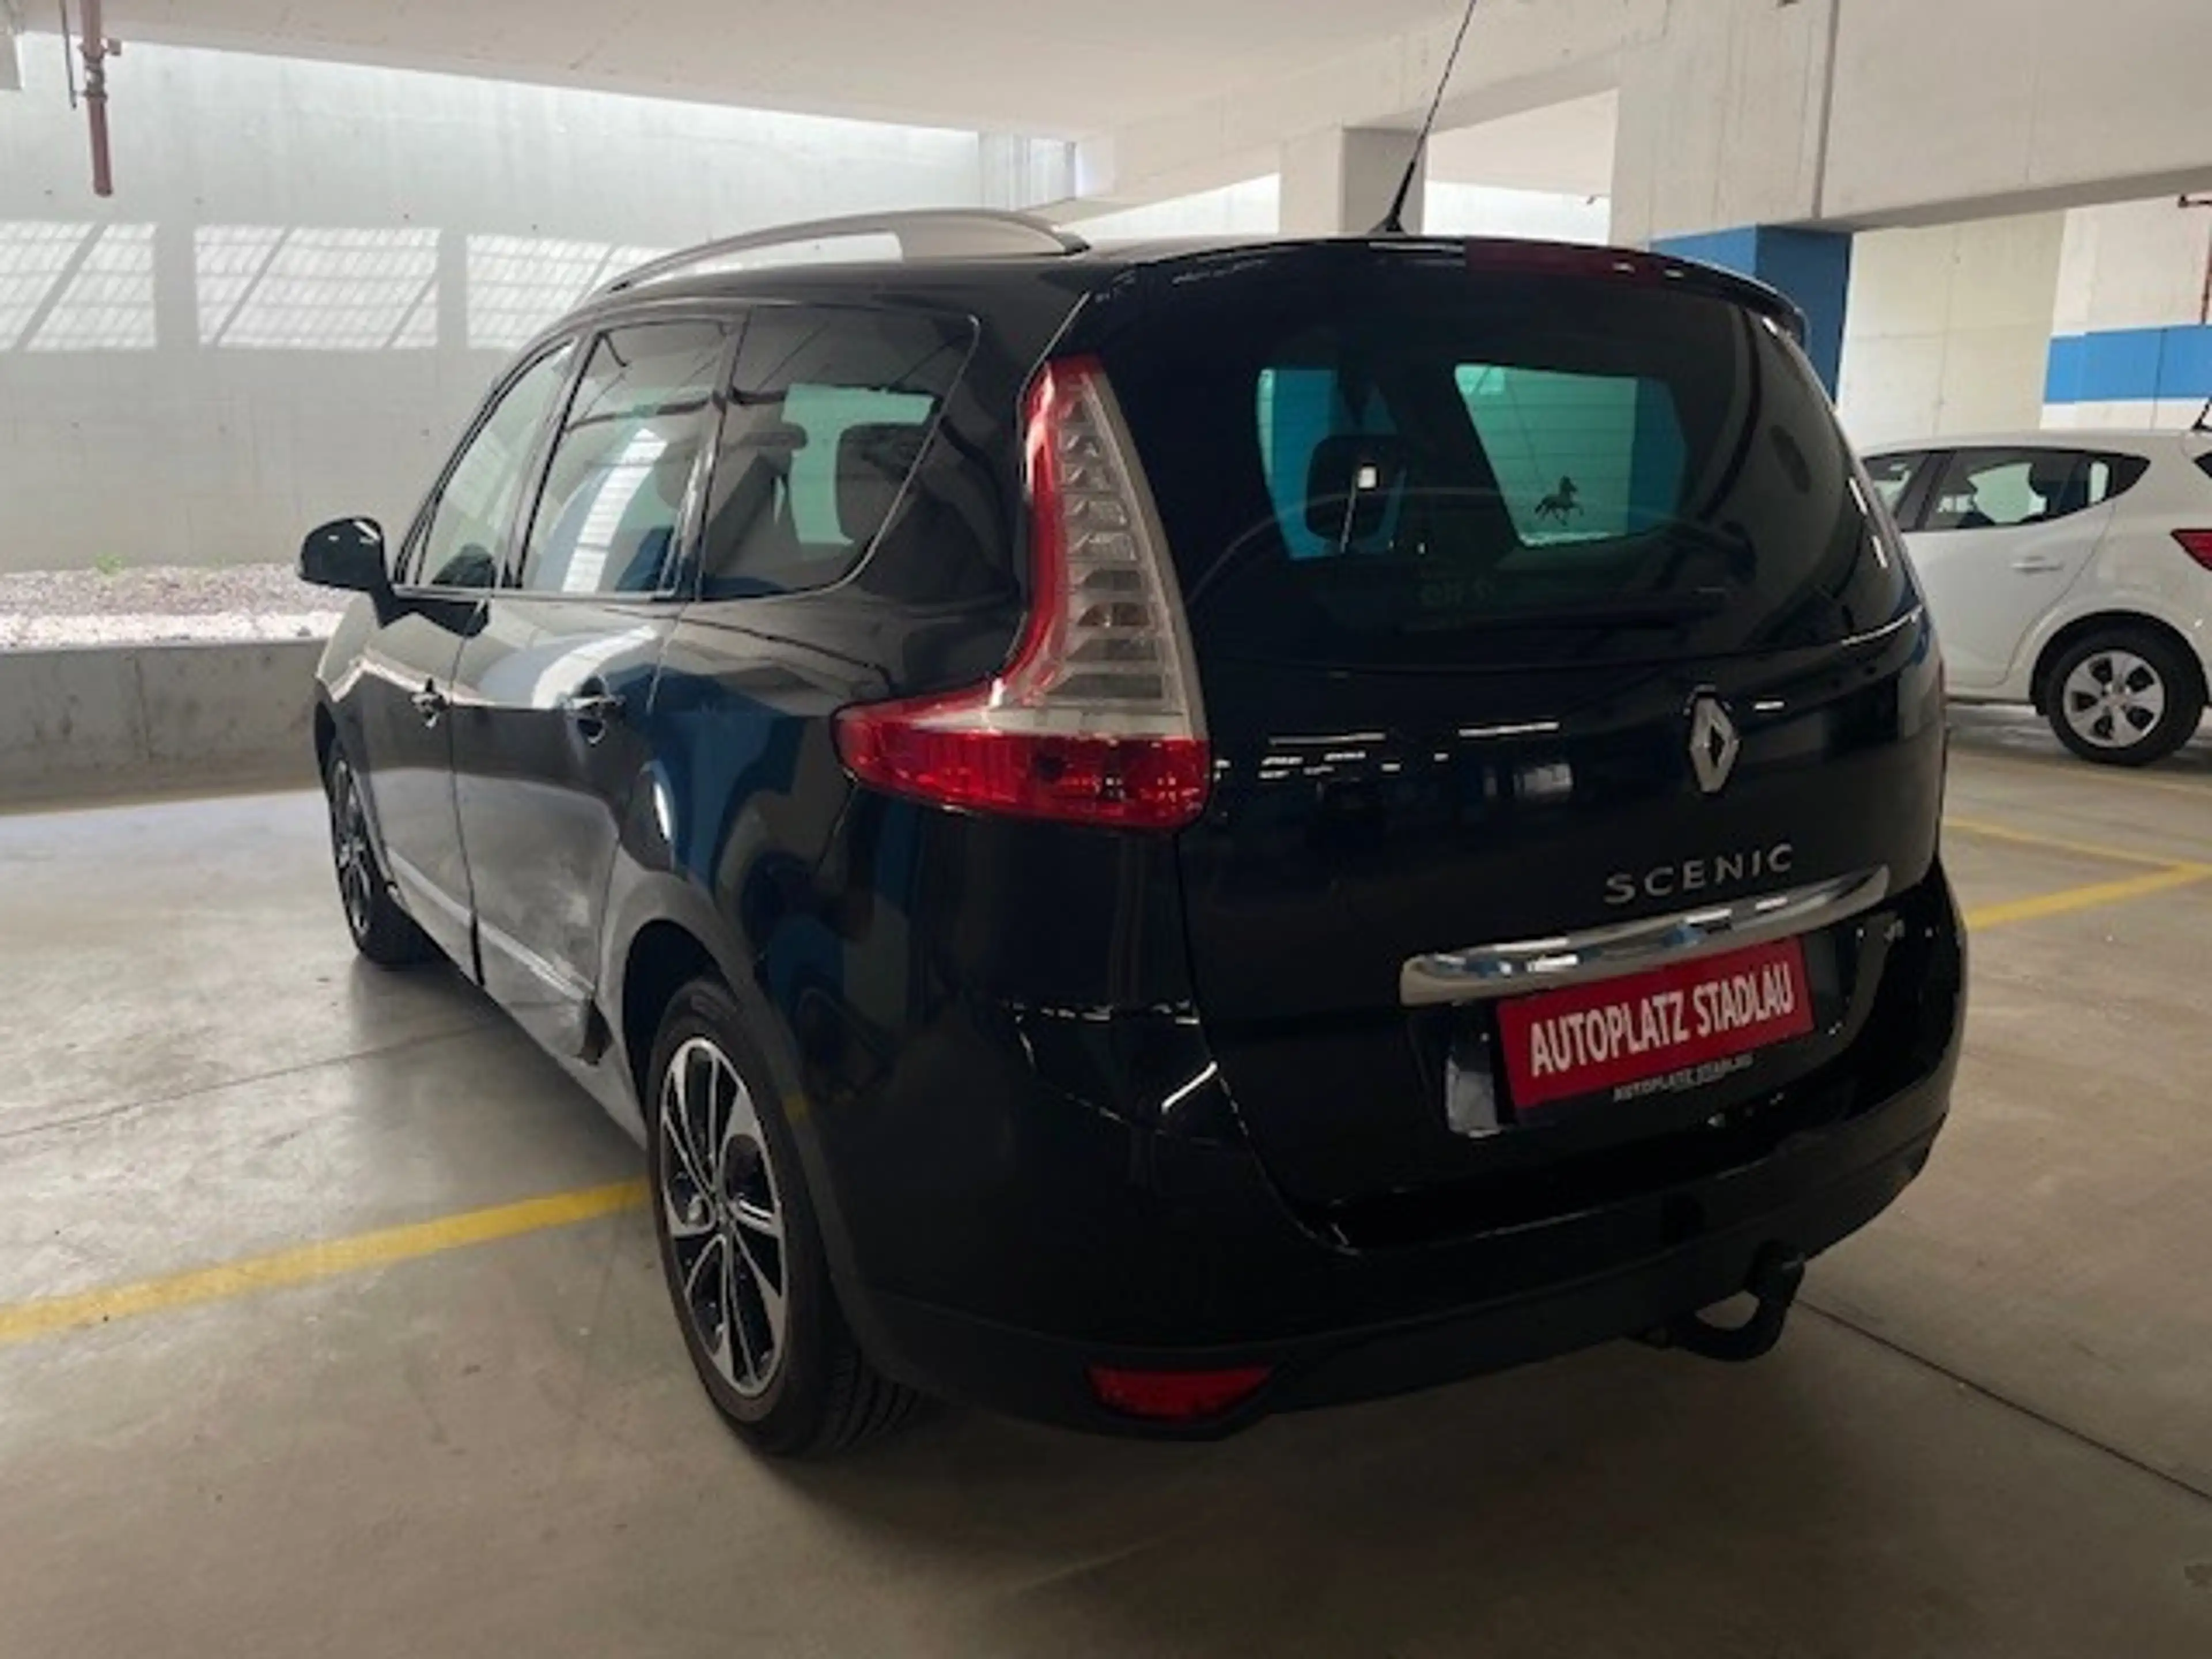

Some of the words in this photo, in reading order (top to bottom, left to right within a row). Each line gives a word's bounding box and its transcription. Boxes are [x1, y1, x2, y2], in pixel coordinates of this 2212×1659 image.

[1604, 843, 1793, 904] SCENIC
[1530, 990, 1690, 1076] AUTOPLATZ
[1692, 963, 1794, 1037] STADLAU
